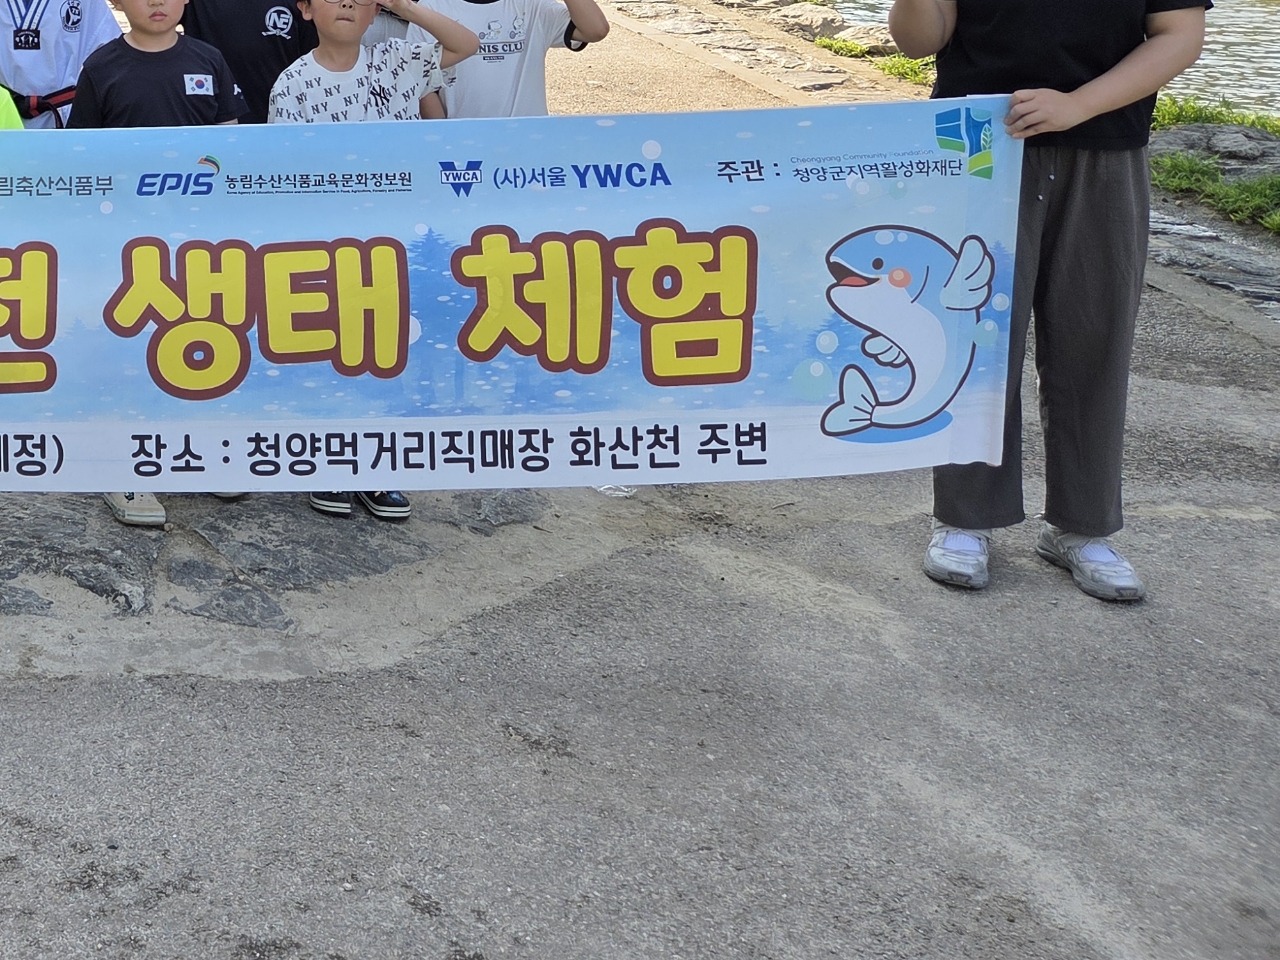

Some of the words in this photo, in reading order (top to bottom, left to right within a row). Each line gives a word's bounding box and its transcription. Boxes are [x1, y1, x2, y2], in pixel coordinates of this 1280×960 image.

[502, 42, 524, 52] CLU
[285, 70, 301, 80] NY
[305, 76, 321, 89] NY
[324, 84, 340, 97] NY
[402, 85, 416, 102] NY
[343, 93, 359, 106] NY
[311, 102, 327, 114] NY
[376, 105, 390, 119] NY
[331, 110, 347, 122] NY
[443, 171, 480, 182] YWCA
[493, 166, 567, 189] (사)서울
[571, 162, 672, 188] YWCA
[717, 160, 765, 183] 주관
[792, 158, 963, 183] 청양군지역활성화재단
[136, 172, 215, 196] EPIS
[225, 172, 412, 189] 농림수산식품교육문화정보원
[103, 236, 409, 401] 생태
[450, 217, 760, 387] 체험
[131, 433, 206, 476] 장소
[246, 429, 554, 476] 청양먹거리직매장
[569, 424, 681, 468] 화산천
[696, 420, 768, 467] 주변
